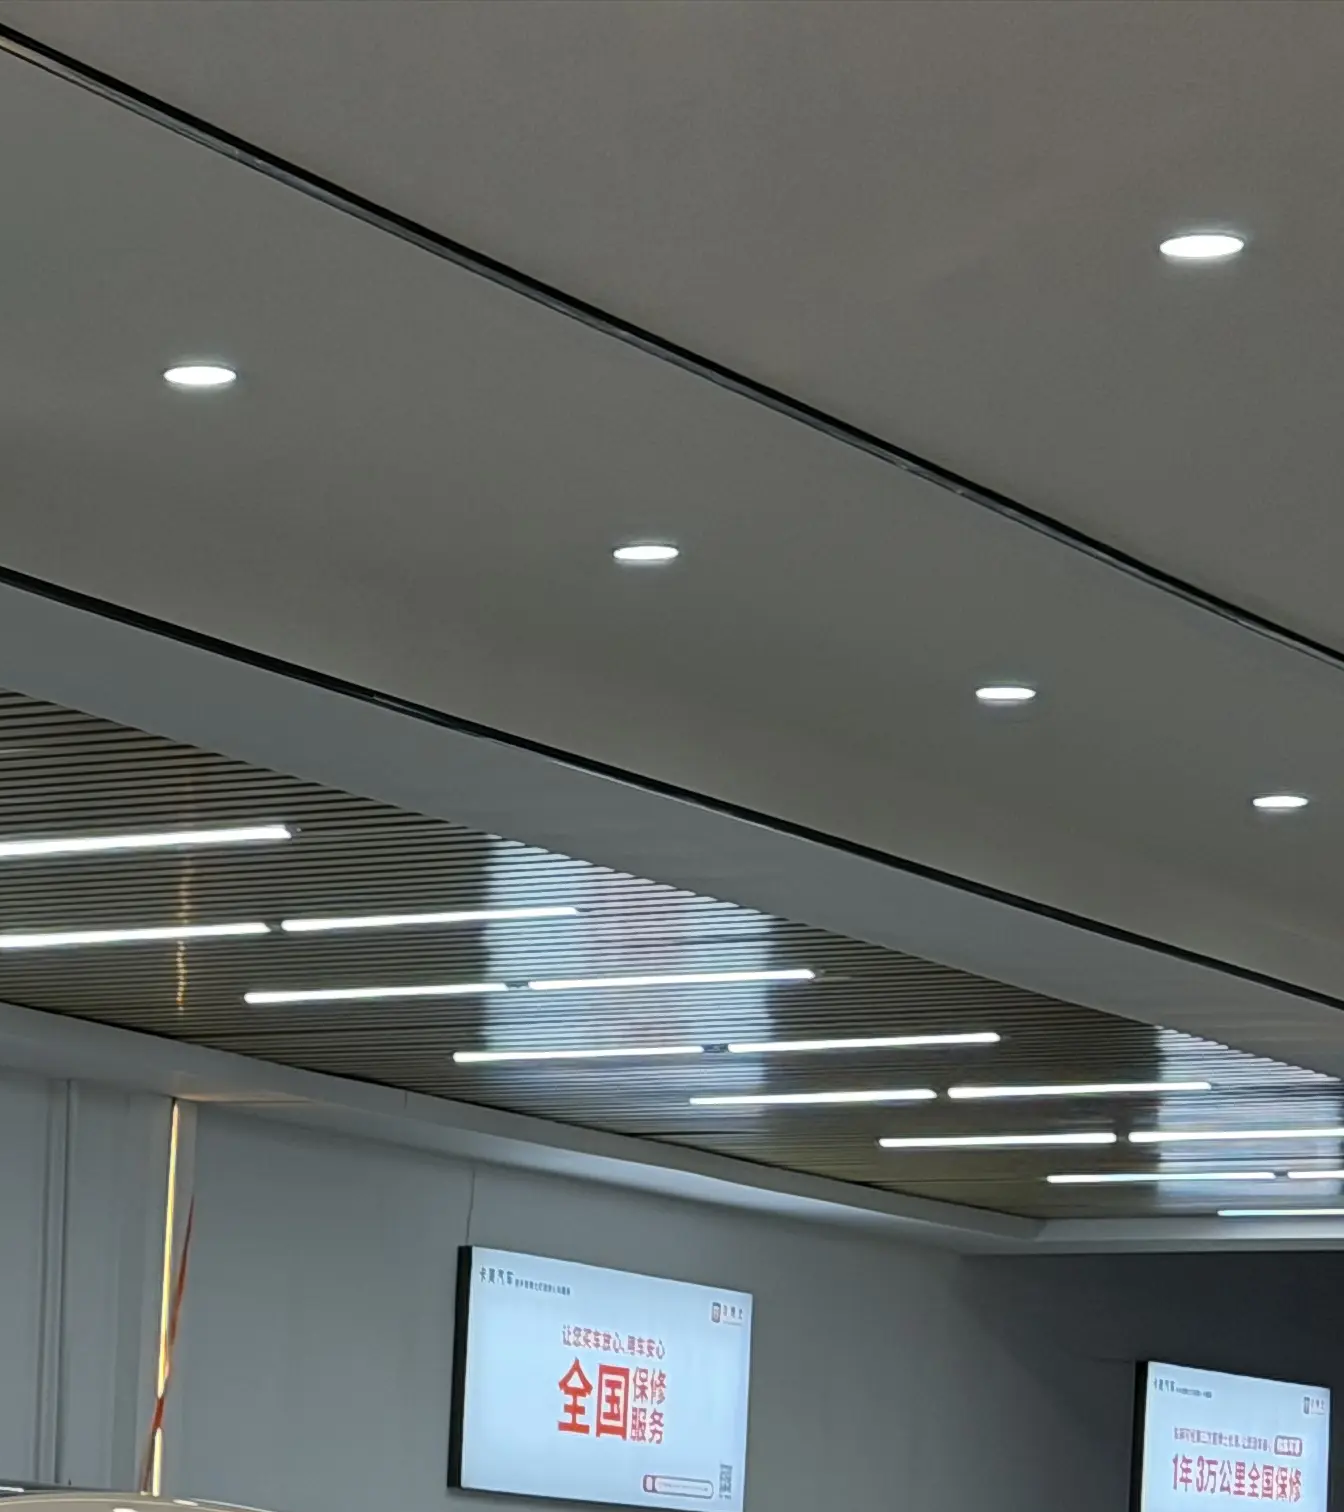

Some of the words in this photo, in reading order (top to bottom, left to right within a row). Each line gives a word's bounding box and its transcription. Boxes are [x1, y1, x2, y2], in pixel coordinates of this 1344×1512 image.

[557, 1356, 630, 1442] 全国
[632, 1366, 667, 1405] 保修
[630, 1406, 665, 1445] 服务
